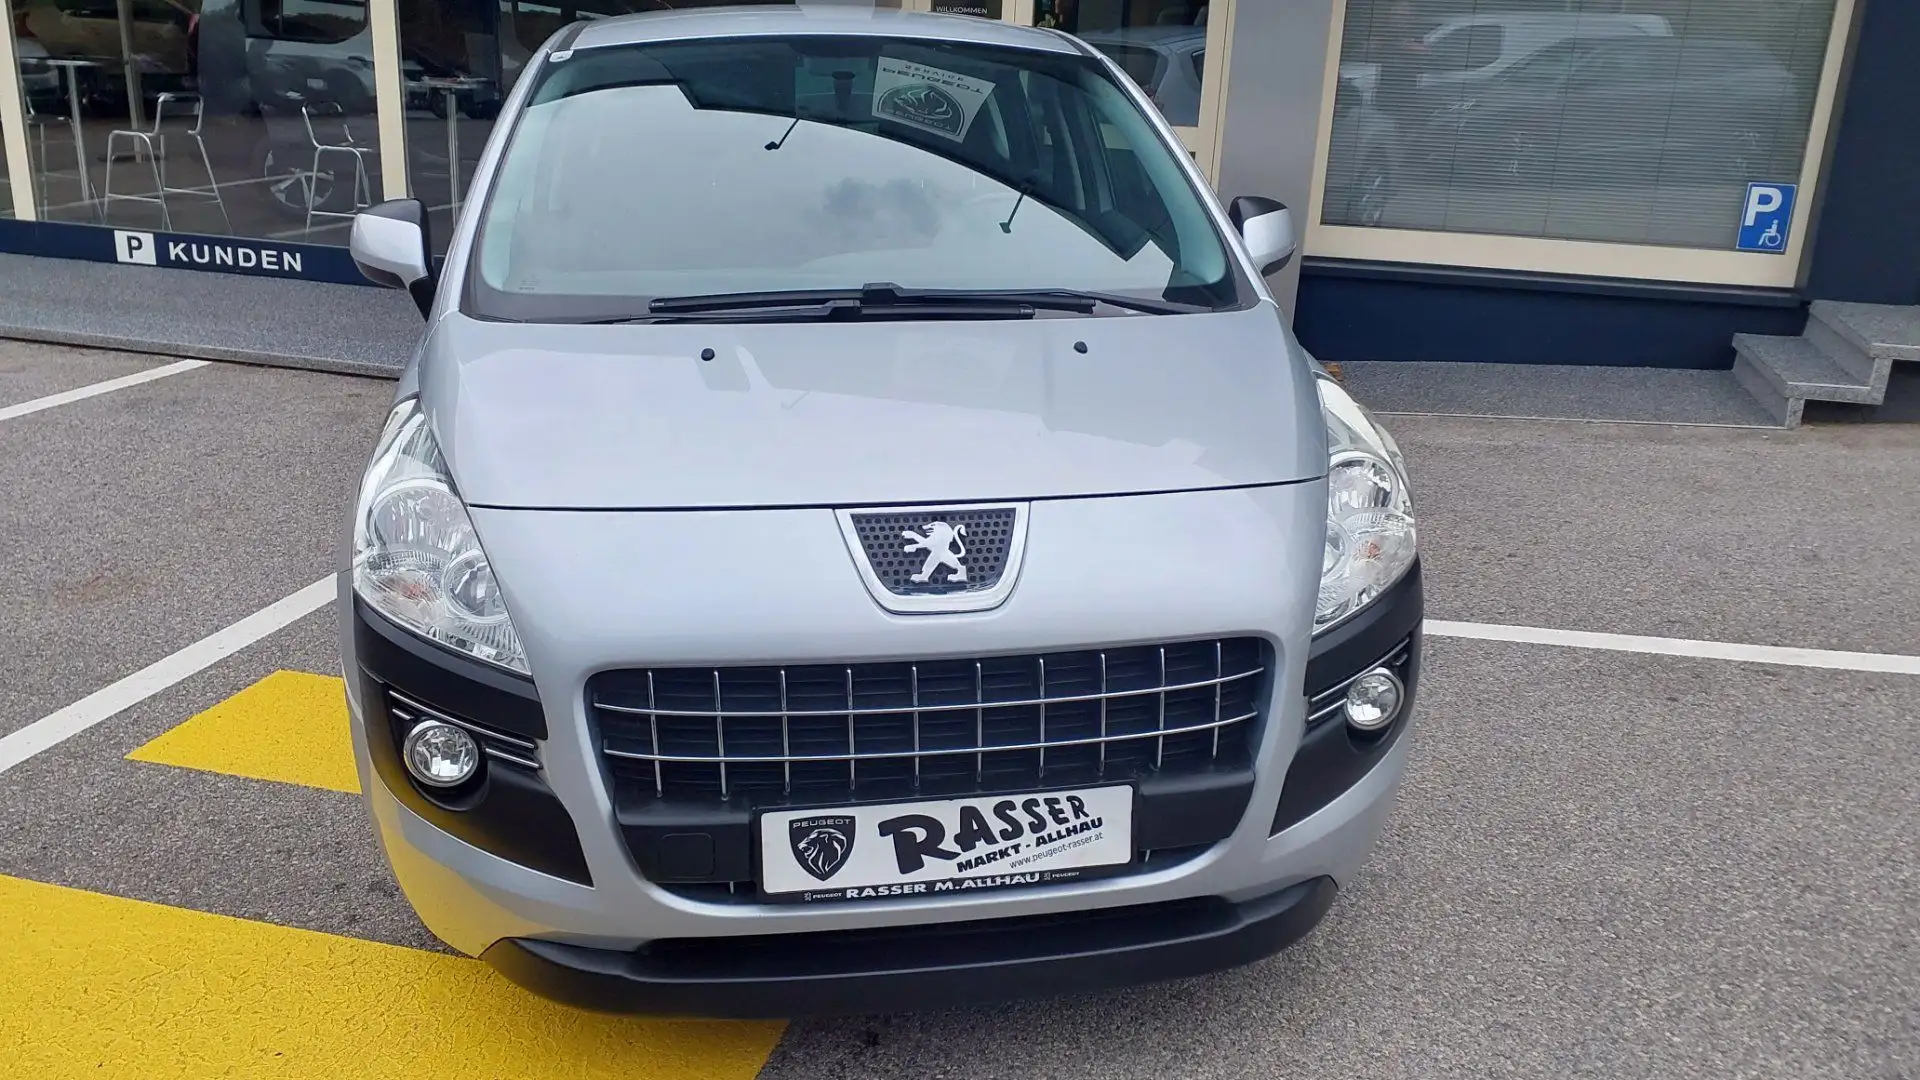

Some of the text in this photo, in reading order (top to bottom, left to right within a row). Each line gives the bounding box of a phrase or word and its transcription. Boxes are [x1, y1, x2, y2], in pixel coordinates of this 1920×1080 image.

[936, 5, 988, 14] WILLKOMMEN
[1744, 186, 1783, 227] P
[126, 235, 303, 273] P KUNDEN
[792, 818, 852, 829] PEUGEOT
[877, 795, 1090, 875] RASSER
[956, 842, 1022, 873] MARKT
[1035, 816, 1104, 848] ALLHAU
[1009, 831, 1104, 870] www.peugeot-rasser.at
[846, 883, 927, 899] RASSER
[934, 872, 1040, 891] M.ALLHAU
